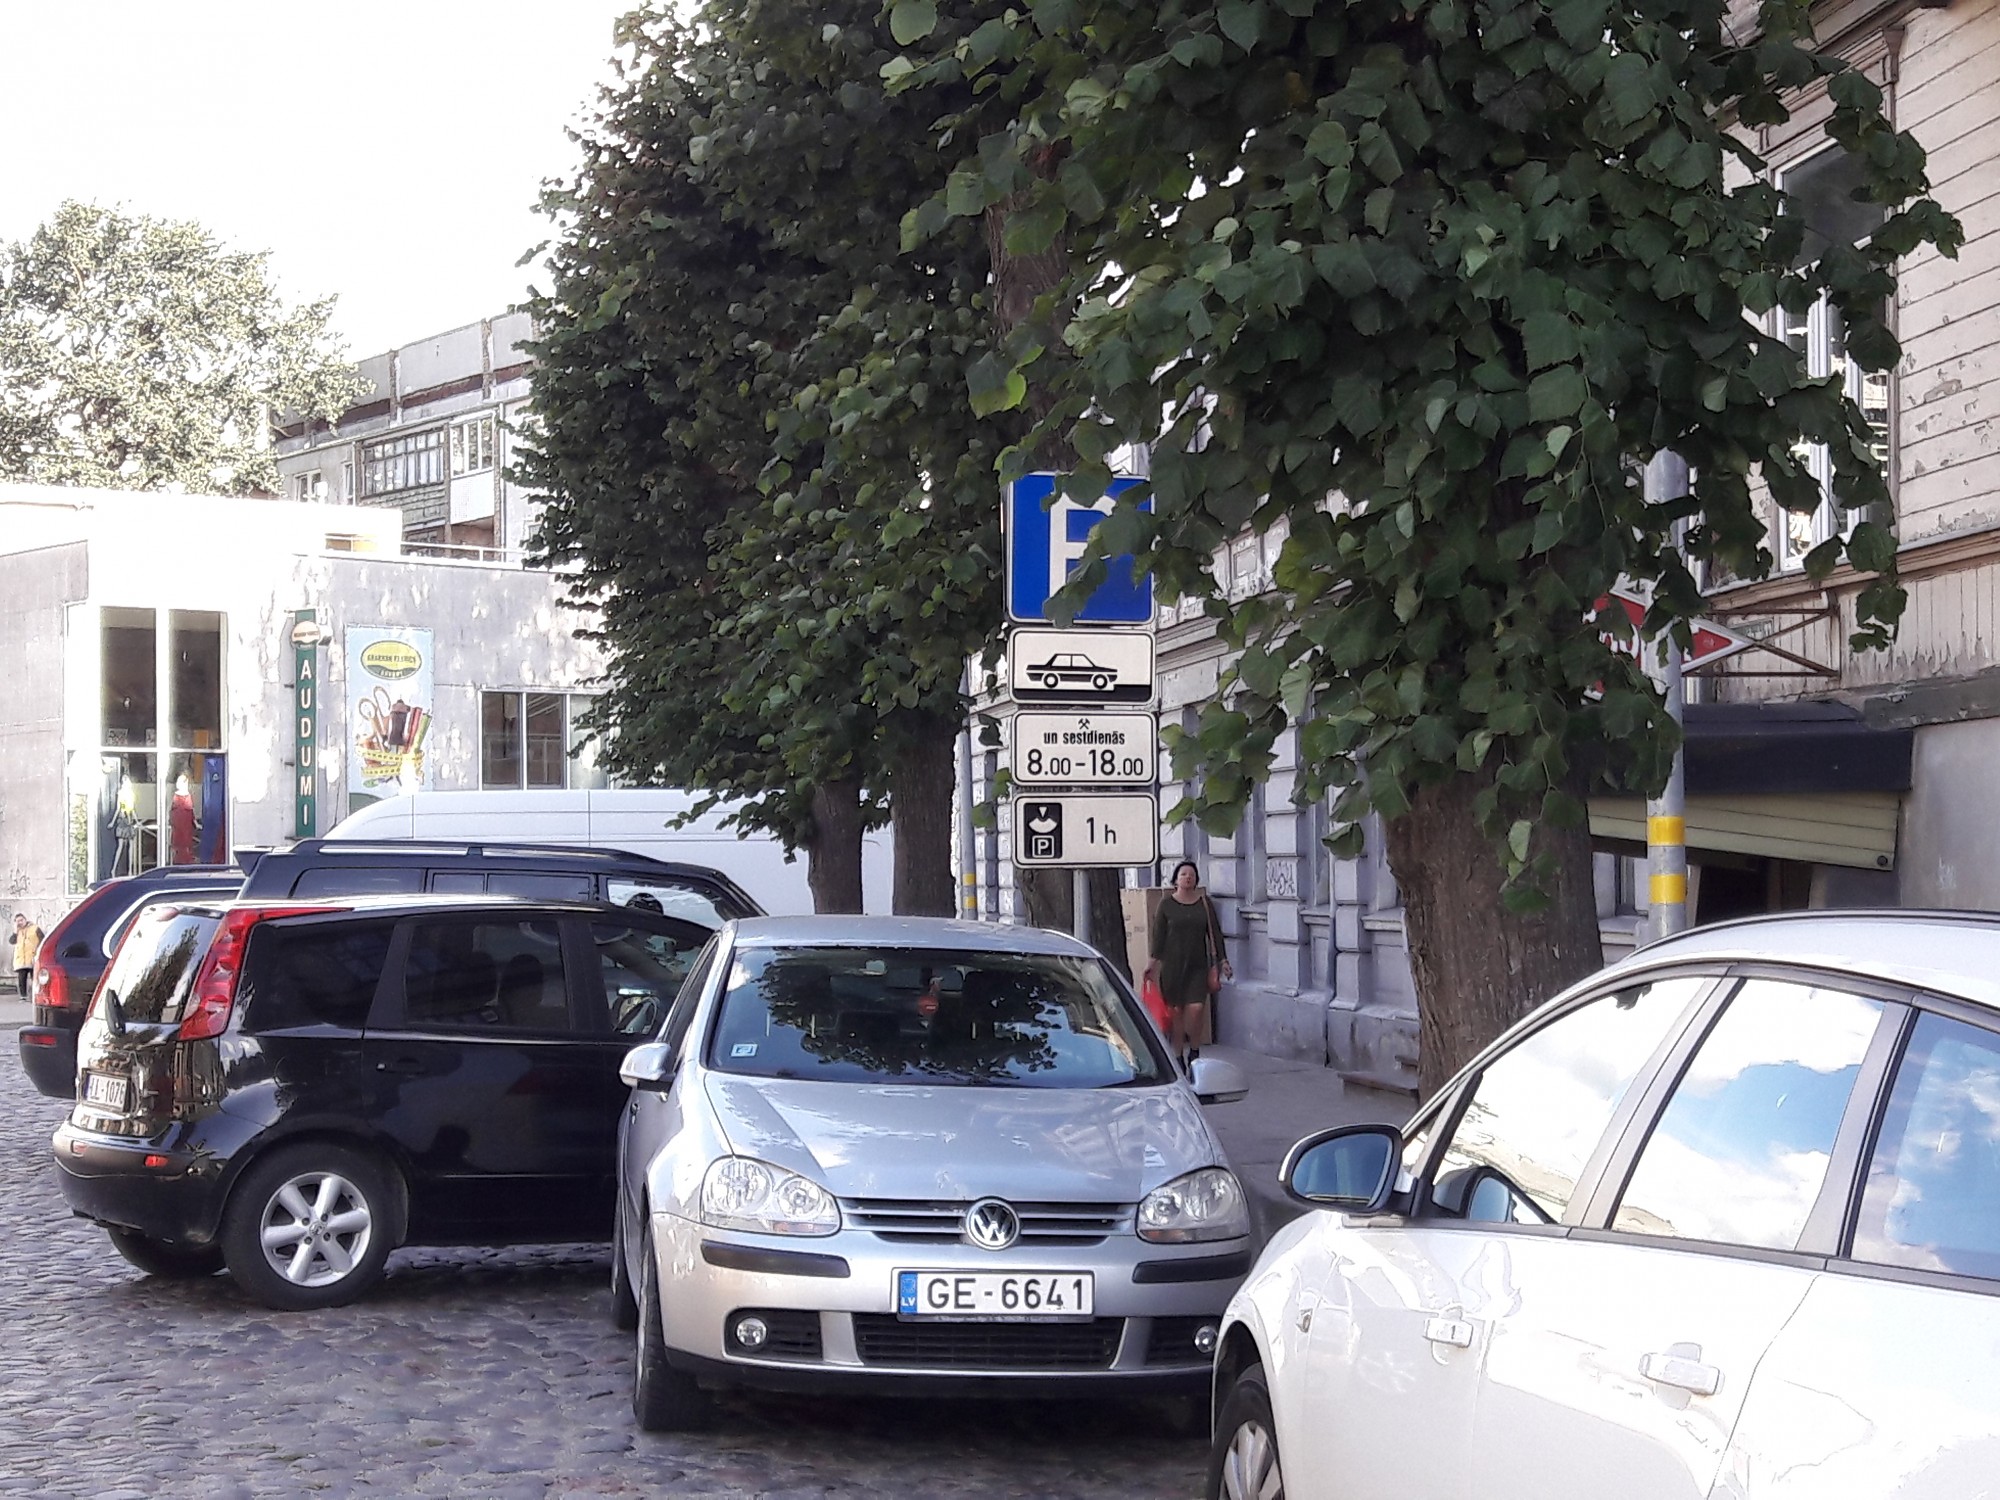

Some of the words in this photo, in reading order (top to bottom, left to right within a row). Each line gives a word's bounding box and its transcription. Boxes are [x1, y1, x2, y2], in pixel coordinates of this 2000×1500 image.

[300, 659, 312, 826] AUDUMI
[1043, 731, 1058, 745] un
[1062, 729, 1126, 745] sestdienās
[1086, 817, 1095, 844] 1
[1104, 824, 1117, 845] h
[1037, 839, 1050, 855] P
[900, 1297, 916, 1306] LV
[927, 1277, 1083, 1311] GE-6641
